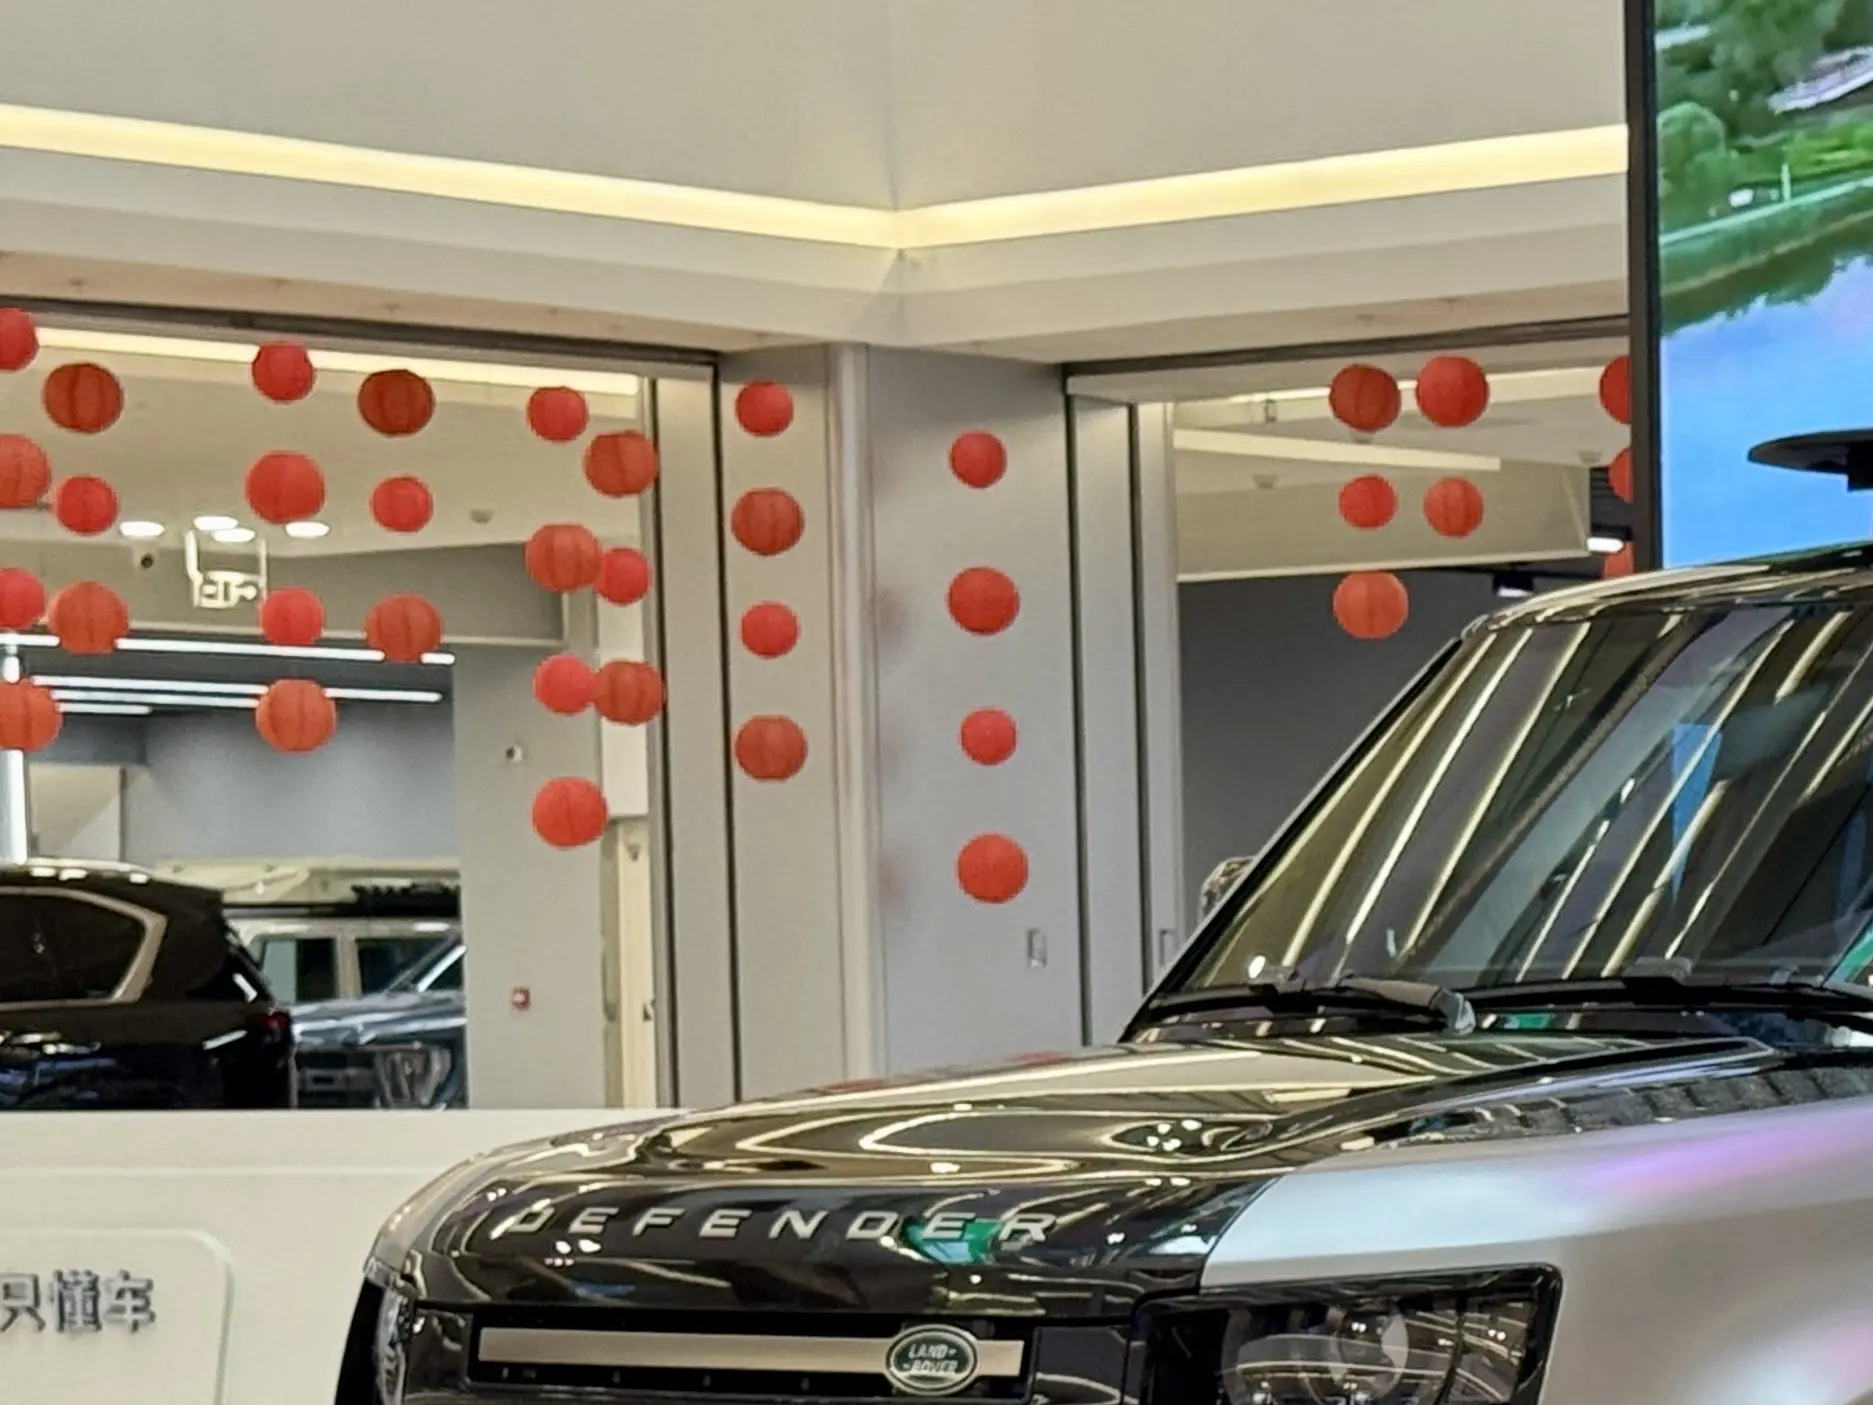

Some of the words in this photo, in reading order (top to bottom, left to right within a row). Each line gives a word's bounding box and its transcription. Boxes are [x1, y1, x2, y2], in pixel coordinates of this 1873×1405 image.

[509, 1205, 1060, 1243] DEFENDER
[0, 1268, 157, 1334] 只懂车
[908, 1343, 948, 1359] LAND
